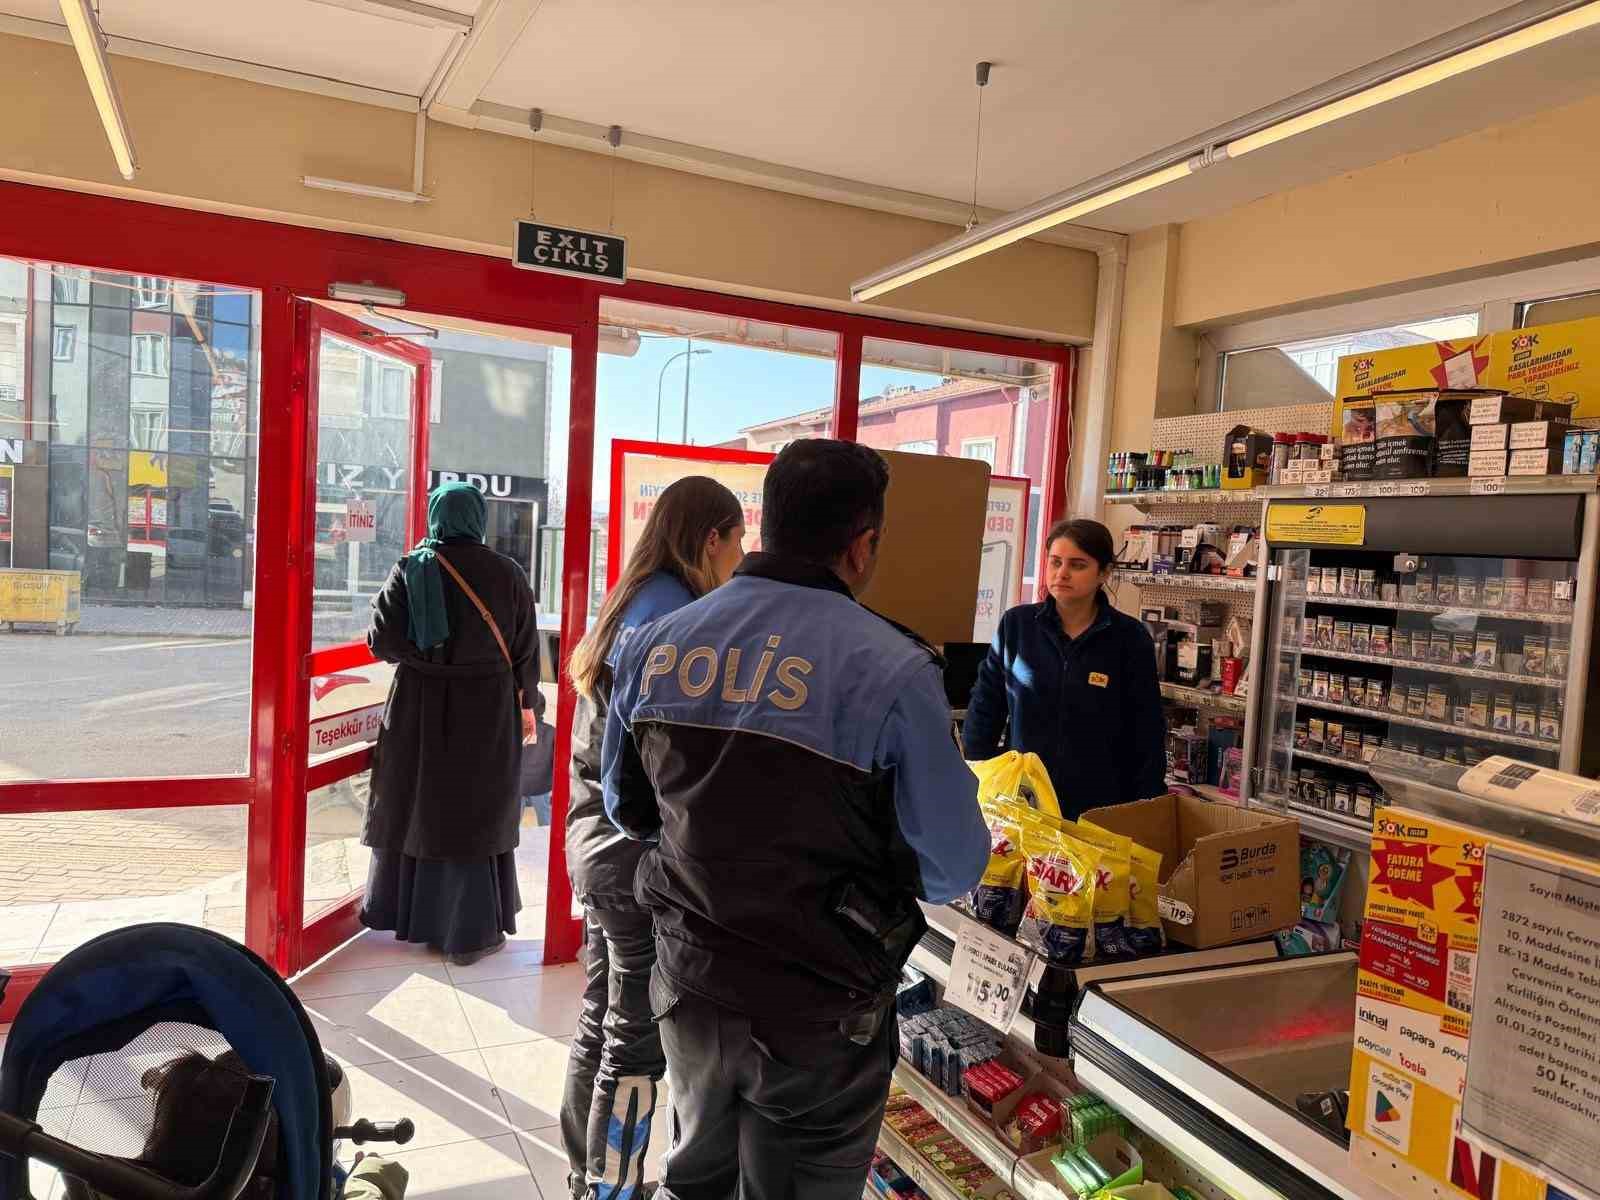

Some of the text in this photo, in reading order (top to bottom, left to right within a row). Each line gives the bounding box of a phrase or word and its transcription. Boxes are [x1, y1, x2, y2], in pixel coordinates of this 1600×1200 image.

[537, 230, 609, 253] EXIT
[533, 245, 609, 272] ÇIKIŞ
[327, 463, 364, 488] IZ
[349, 510, 375, 529] İTİNİZ
[639, 634, 813, 711] POLİS
[315, 717, 363, 746] Teşekkür
[1378, 818, 1406, 838] ŞOK
[1240, 842, 1277, 864] Burda
[1387, 854, 1424, 868] FATURA
[1462, 841, 1485, 861] ŞO
[1386, 866, 1423, 883] ÖDEME
[1529, 883, 1563, 902] Sayın
[1501, 909, 1529, 928] 2872
[1531, 921, 1563, 938] sayılı
[1506, 929, 1591, 966] 10. Maddesine
[1497, 943, 1530, 963] EK-13
[1532, 956, 1575, 979] Madde
[1511, 967, 1563, 993] Çevrenin
[1506, 983, 1556, 1009] Kirliliğin
[1359, 1006, 1388, 1028] ininal
[1494, 997, 1596, 1043] Alışveriş Poşetleri
[1357, 1035, 1392, 1057] paycell
[1400, 1026, 1436, 1049] papara
[1495, 1014, 1597, 1064] 01.01.2025 tarihi
[1400, 1053, 1427, 1077] tosla
[1518, 1043, 1589, 1079] adet başına
[1371, 1074, 1395, 1093] Google
[1395, 1087, 1410, 1103] Play
[1536, 1063, 1556, 1082] 50
[1559, 1073, 1580, 1094] kr.
[1532, 1087, 1600, 1123] satılacaktır.
